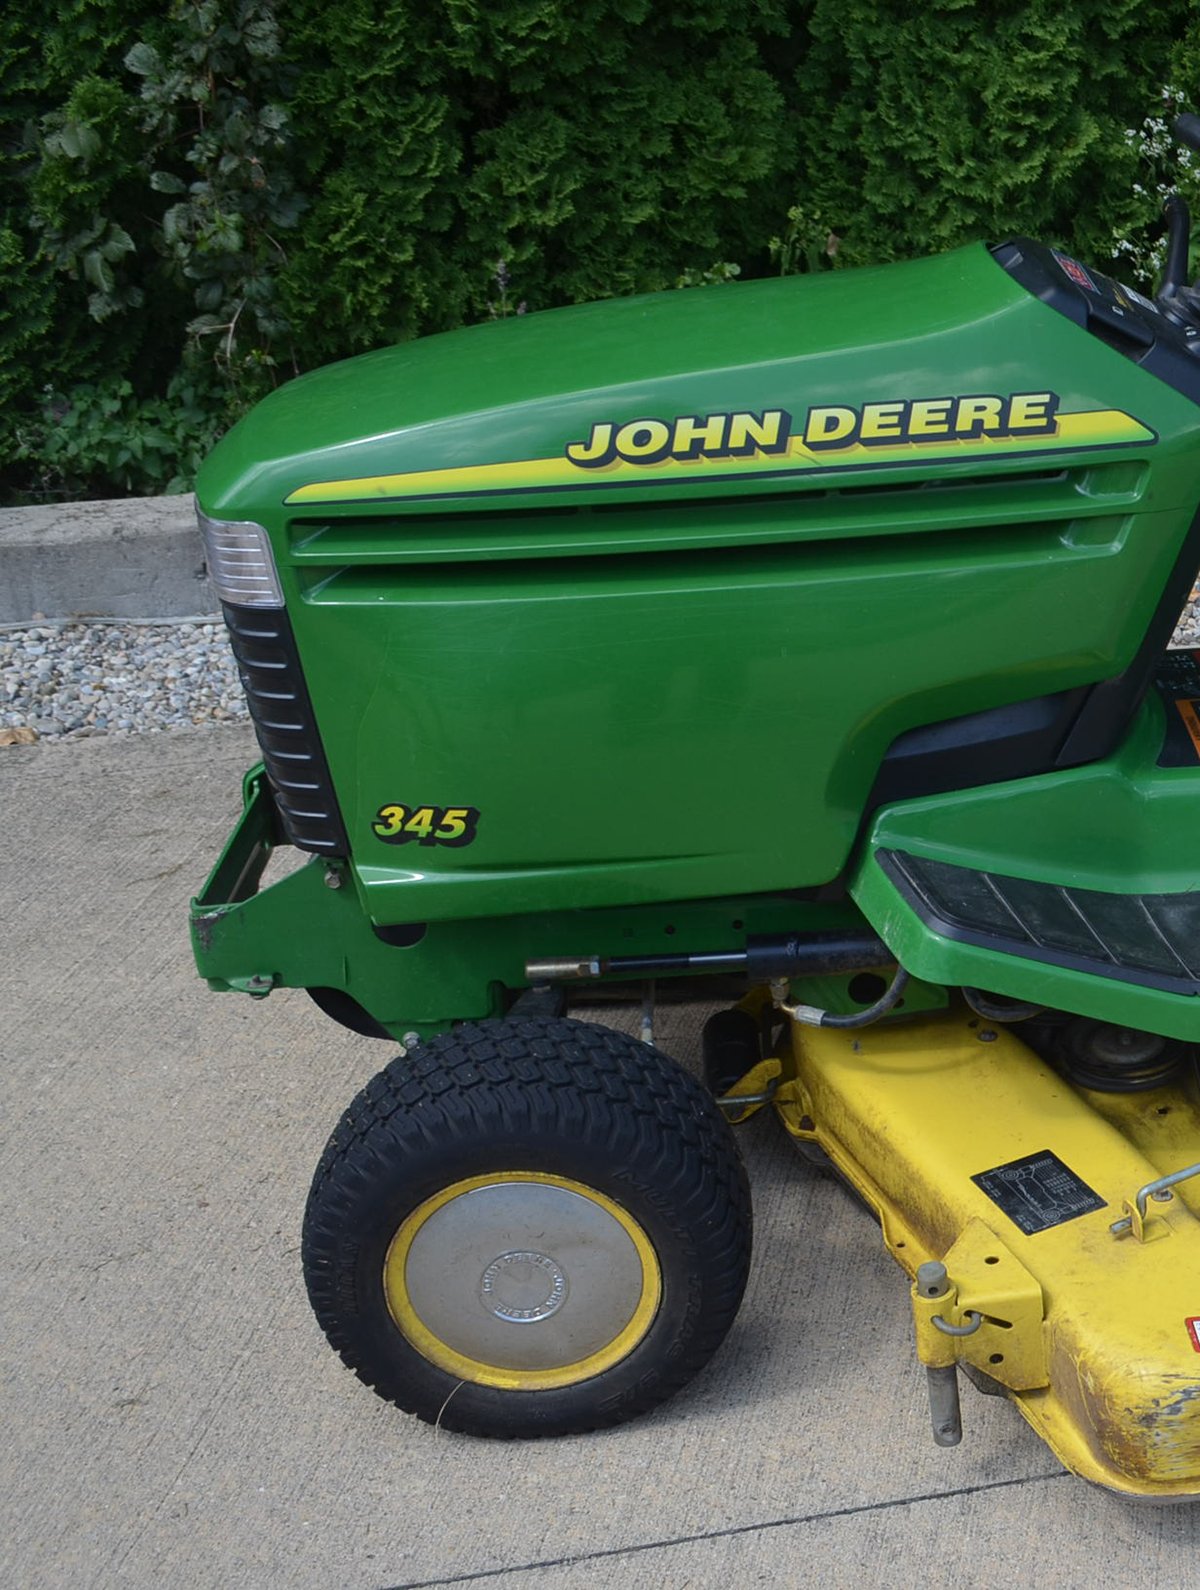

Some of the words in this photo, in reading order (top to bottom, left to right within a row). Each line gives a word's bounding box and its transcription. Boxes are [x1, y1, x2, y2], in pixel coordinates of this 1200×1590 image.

[565, 409, 792, 470] JOHN
[800, 390, 1059, 451] DEERE
[371, 803, 478, 847] 345
